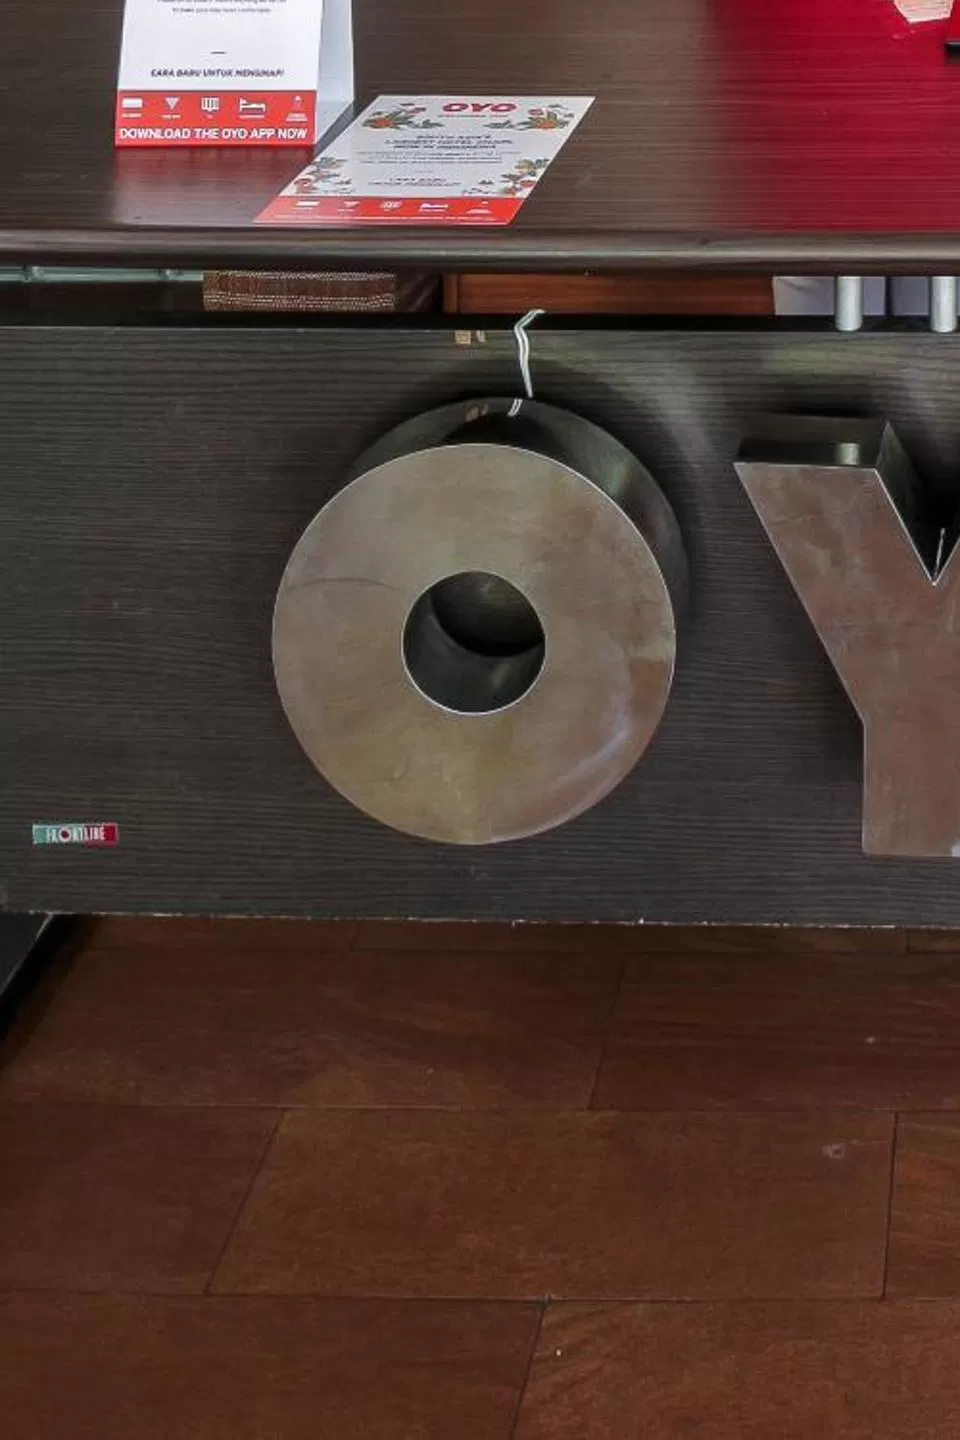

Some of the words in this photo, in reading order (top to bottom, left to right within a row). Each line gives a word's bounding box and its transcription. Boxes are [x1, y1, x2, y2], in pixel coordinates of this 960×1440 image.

[442, 102, 518, 112] OYO
[119, 128, 191, 140] DOWNLOAD
[193, 128, 218, 140] THE
[222, 128, 247, 140] OYO
[250, 128, 275, 140] APP
[278, 128, 308, 140] NOW
